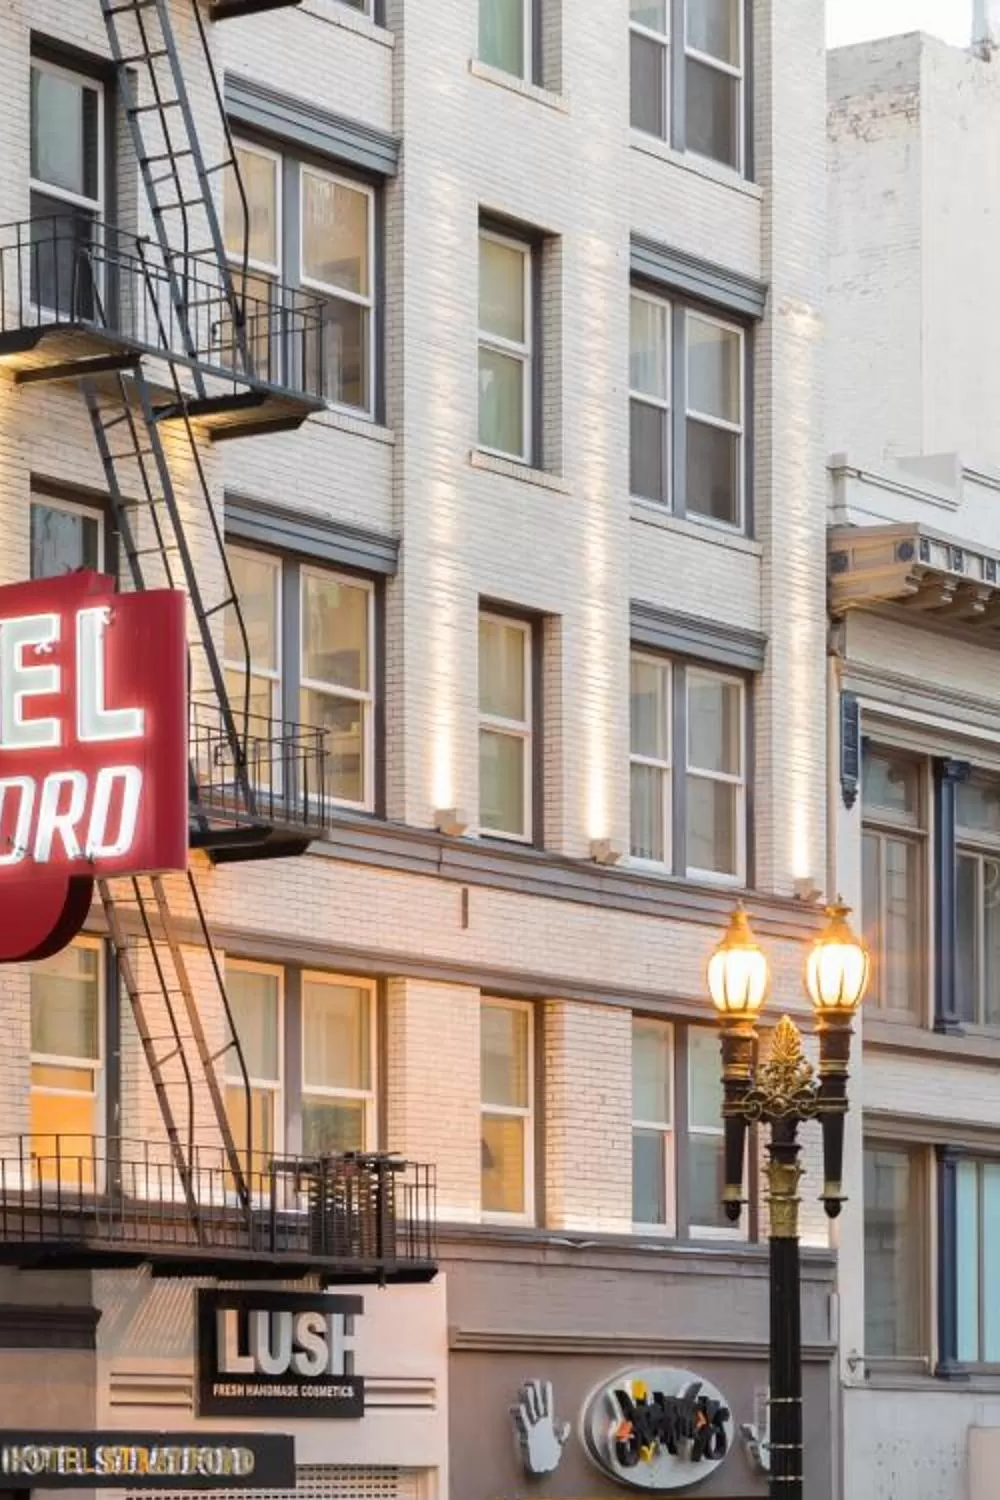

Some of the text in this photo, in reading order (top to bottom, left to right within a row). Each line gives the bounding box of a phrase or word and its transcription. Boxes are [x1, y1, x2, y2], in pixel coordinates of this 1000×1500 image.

[216, 1309, 366, 1377] LUSH
[213, 1383, 355, 1398] FRESH HANDMADE COSMETICS
[1, 1445, 256, 1476] HOTEL STRATFORD
